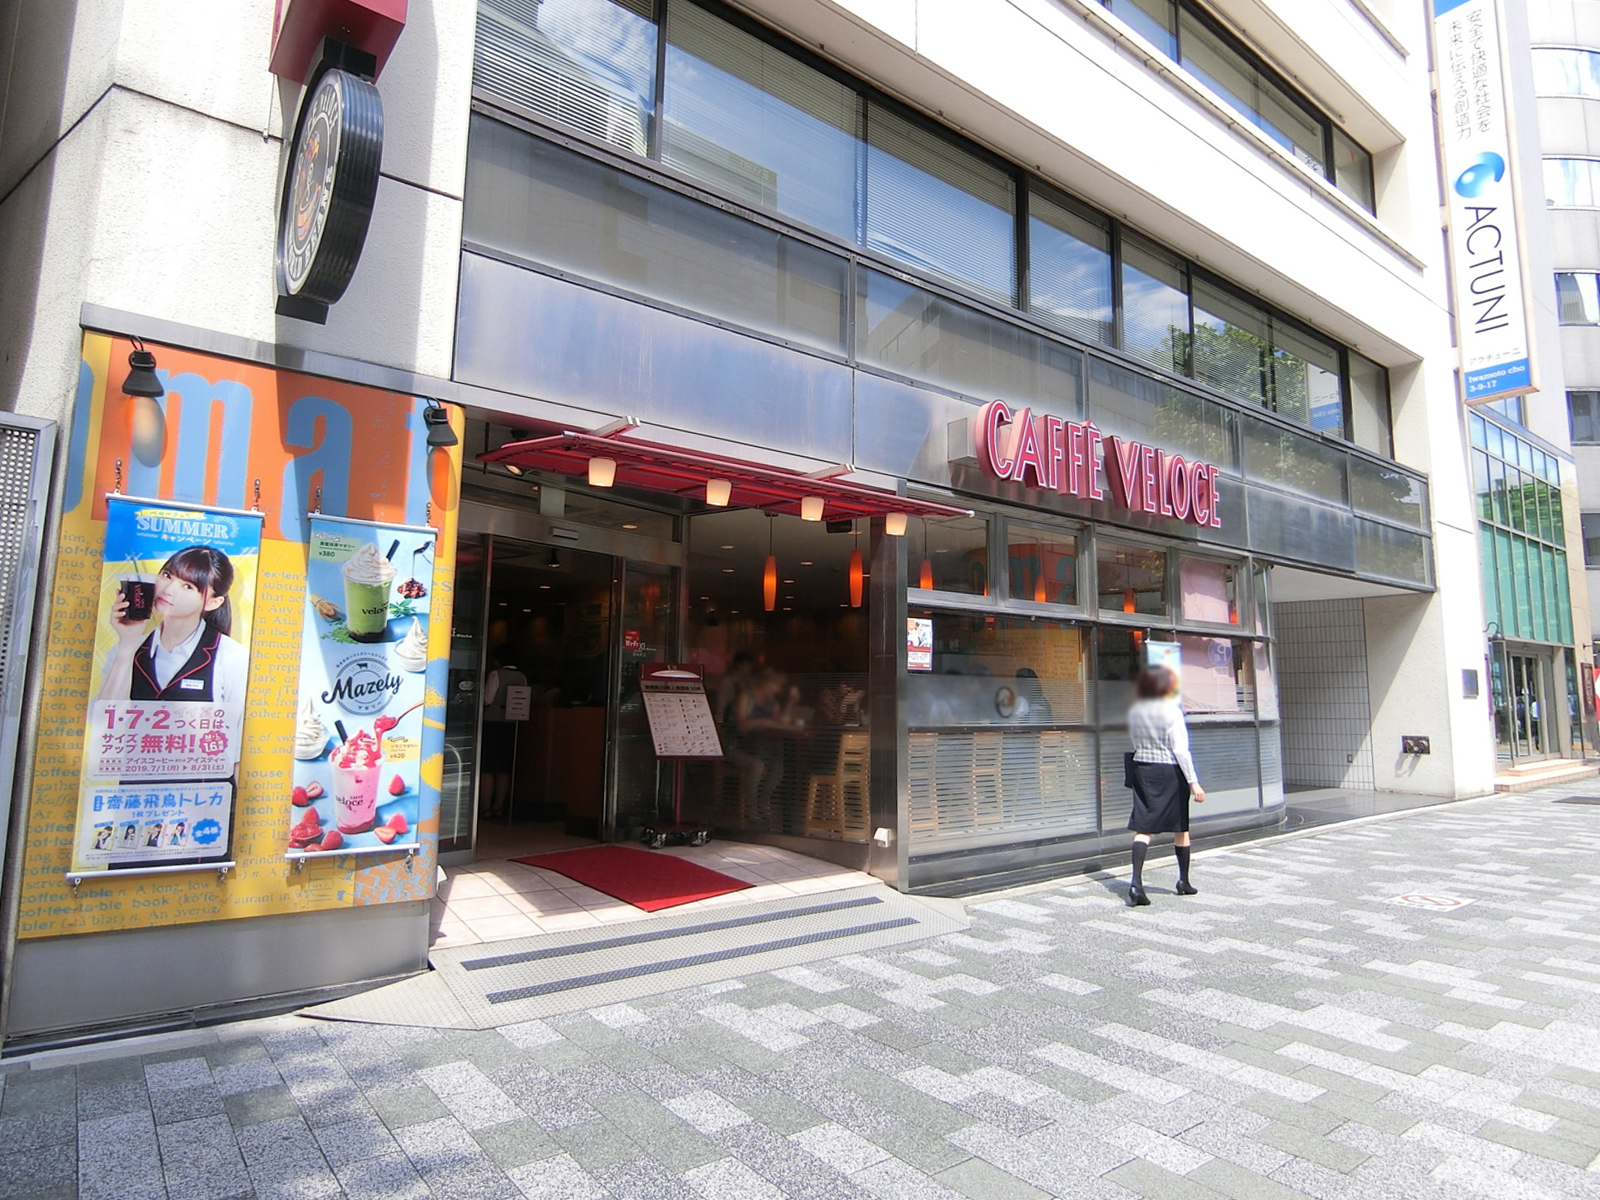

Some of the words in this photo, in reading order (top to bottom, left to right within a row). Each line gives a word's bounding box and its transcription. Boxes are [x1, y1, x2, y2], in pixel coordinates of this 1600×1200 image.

[1466, 9, 1492, 133] 安全で快適な社会を
[1448, 20, 1472, 142] 未来に伝える創造力
[1463, 206, 1509, 334] ACTUNI
[1469, 347, 1521, 366] アクチューニ
[1468, 369, 1507, 383] Iwamoto
[1507, 364, 1525, 375] cho
[1468, 380, 1497, 393] 3-9-17
[1106, 436, 1222, 529] VELOCE
[136, 516, 229, 539] SUMMER
[161, 534, 212, 544] キャンペーン
[321, 672, 404, 704] Mazely
[357, 701, 382, 711] マゼリー
[102, 733, 139, 744] サイズ
[102, 744, 138, 754] アップ
[132, 810, 185, 818] 1枚プレゼント
